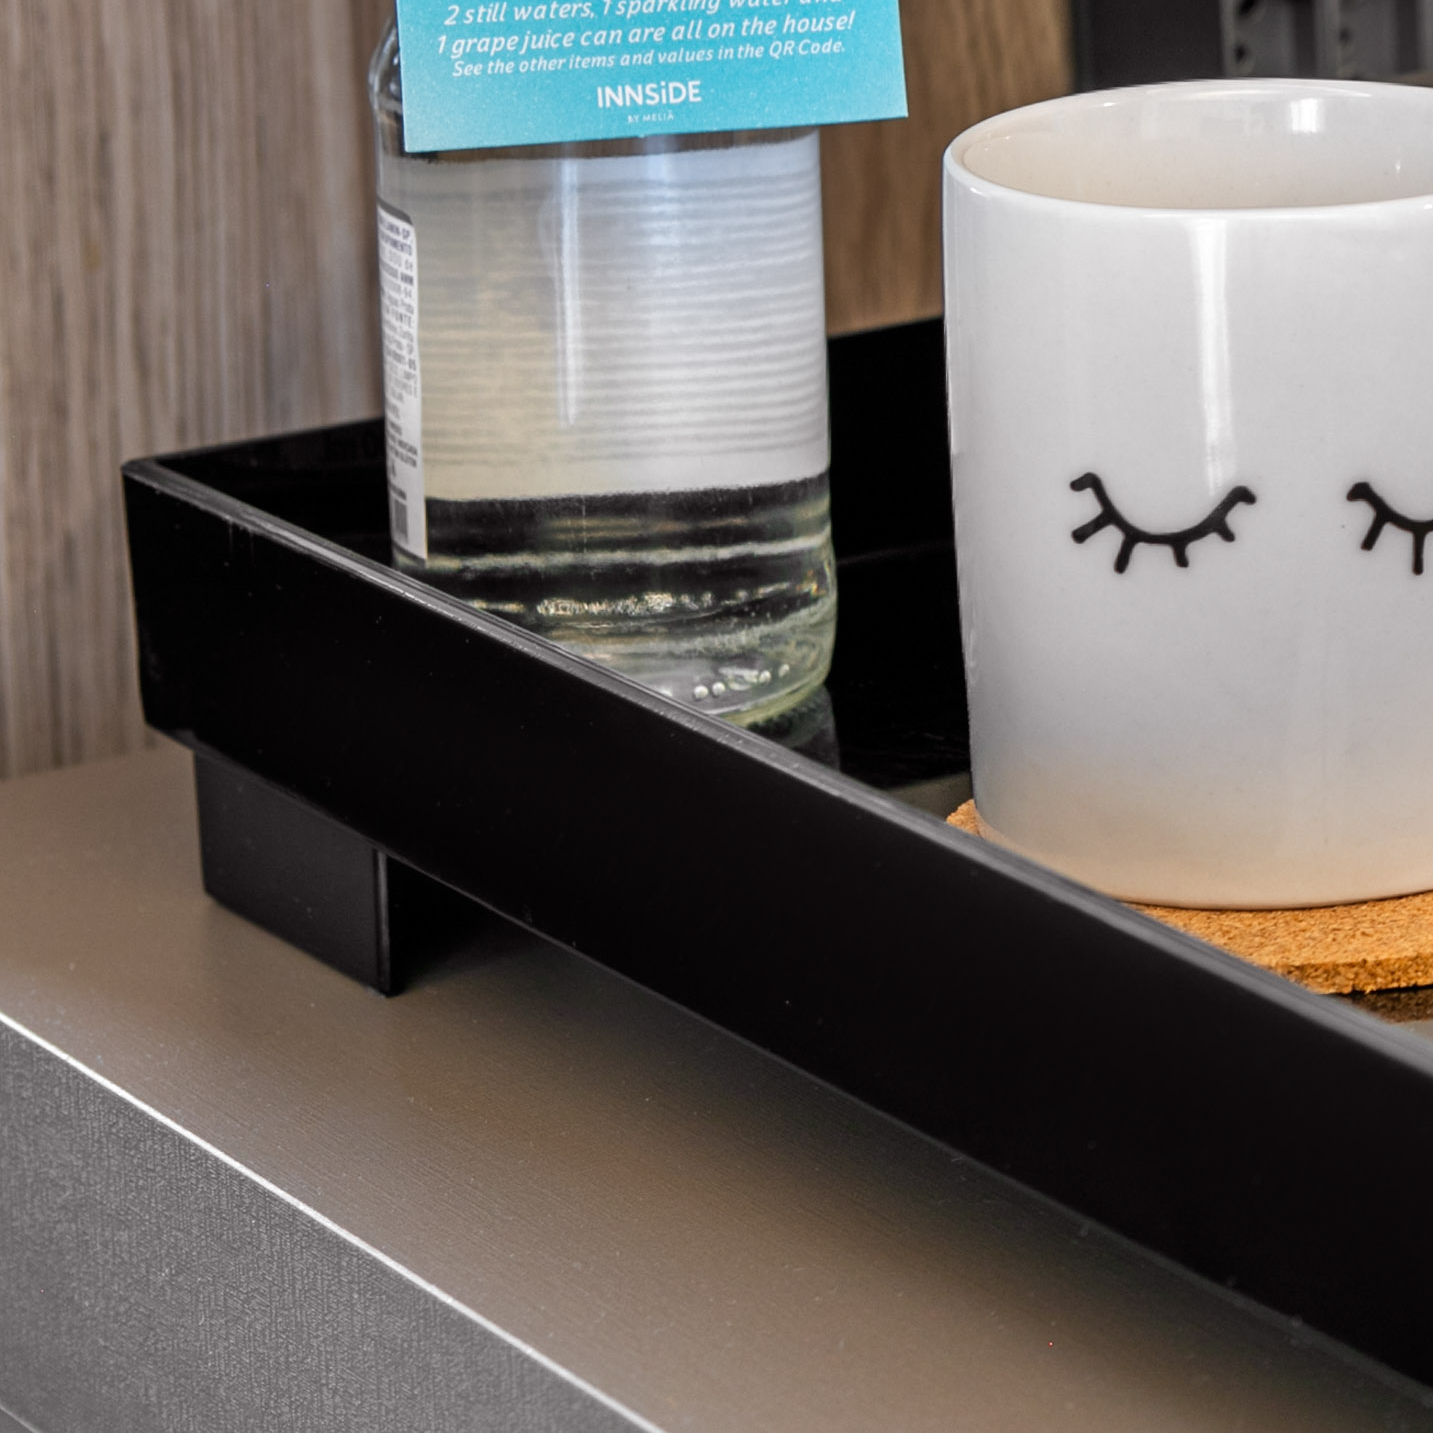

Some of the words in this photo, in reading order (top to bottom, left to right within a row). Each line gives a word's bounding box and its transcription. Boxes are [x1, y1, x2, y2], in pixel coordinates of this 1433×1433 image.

[444, 5, 460, 26] 2
[464, 2, 507, 24] still
[514, 1, 594, 20] waters,
[438, 35, 446, 54] 1
[451, 36, 519, 60] grape
[519, 30, 575, 55] juice
[580, 29, 622, 46] can
[628, 27, 666, 43] are
[672, 19, 702, 41] all
[708, 23, 735, 38] on
[741, 16, 777, 36] the
[783, 10, 856, 33] house!
[452, 61, 483, 77] See
[487, 59, 514, 74] the
[519, 56, 566, 73] other
[569, 55, 615, 69] items
[620, 50, 654, 66] and
[658, 47, 713, 63] values
[718, 46, 734, 60] in
[737, 43, 764, 59] the
[769, 40, 795, 59] QR
[798, 38, 844, 55] Code.
